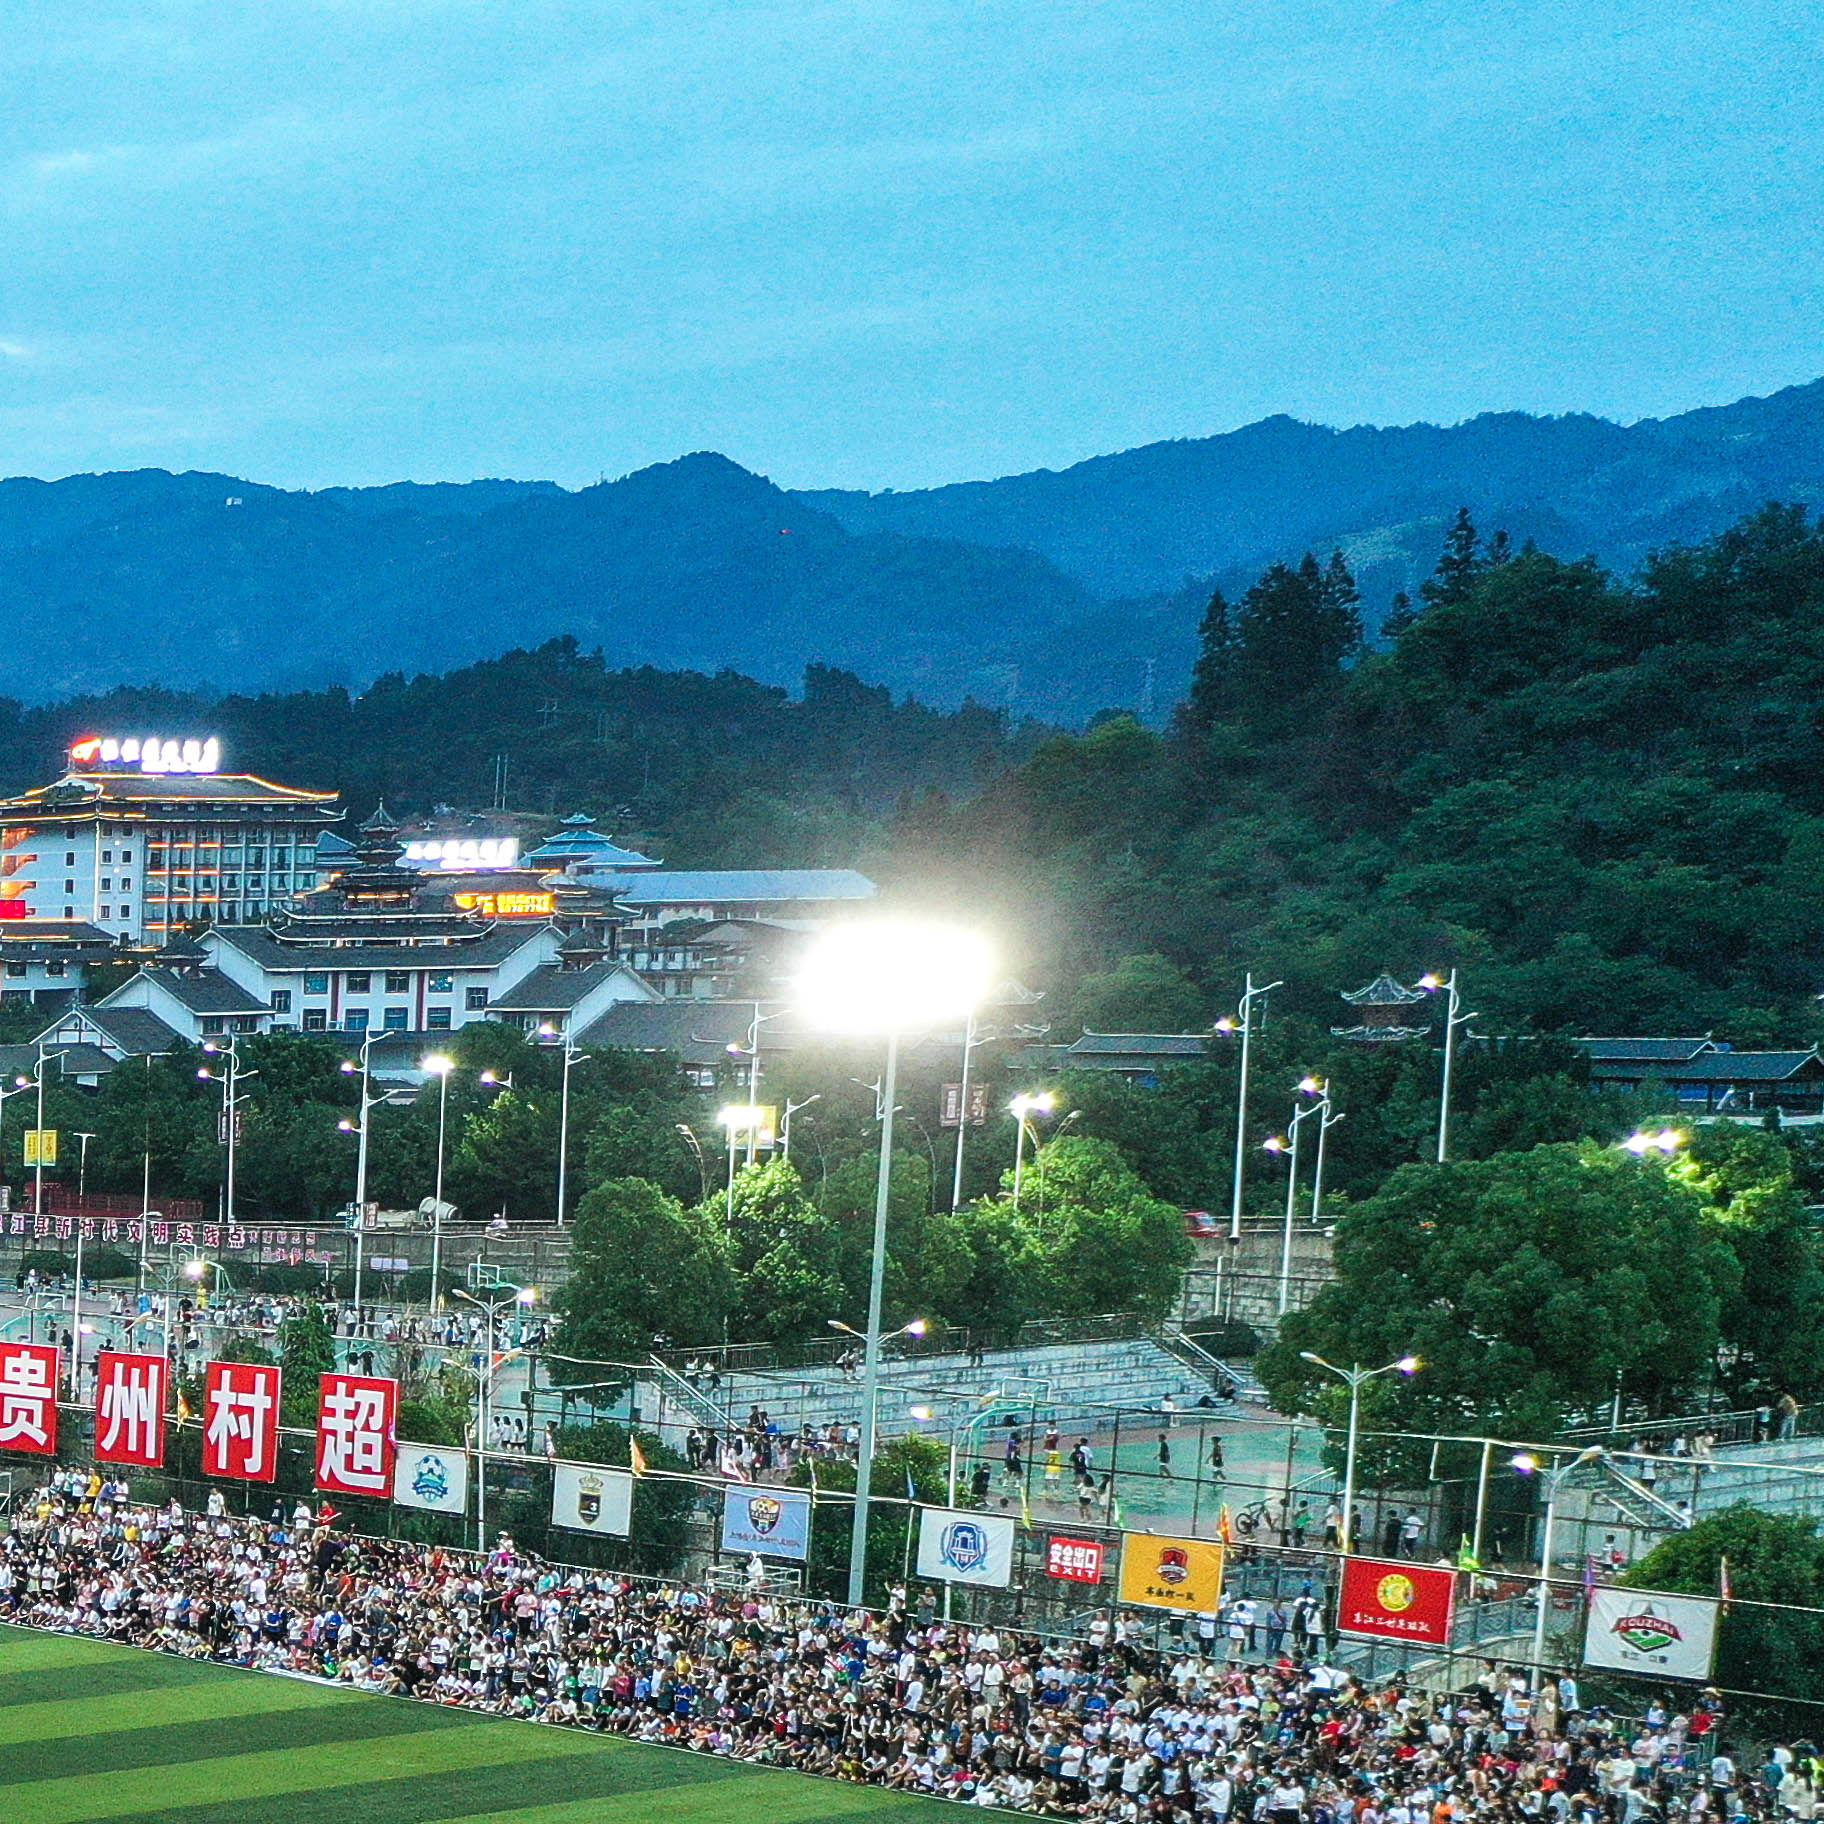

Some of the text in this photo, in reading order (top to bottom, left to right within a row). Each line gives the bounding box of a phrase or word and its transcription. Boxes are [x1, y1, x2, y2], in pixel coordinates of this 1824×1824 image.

[1050, 1543, 1097, 1570] 安全出口
[1050, 1565, 1095, 1578] EXIT
